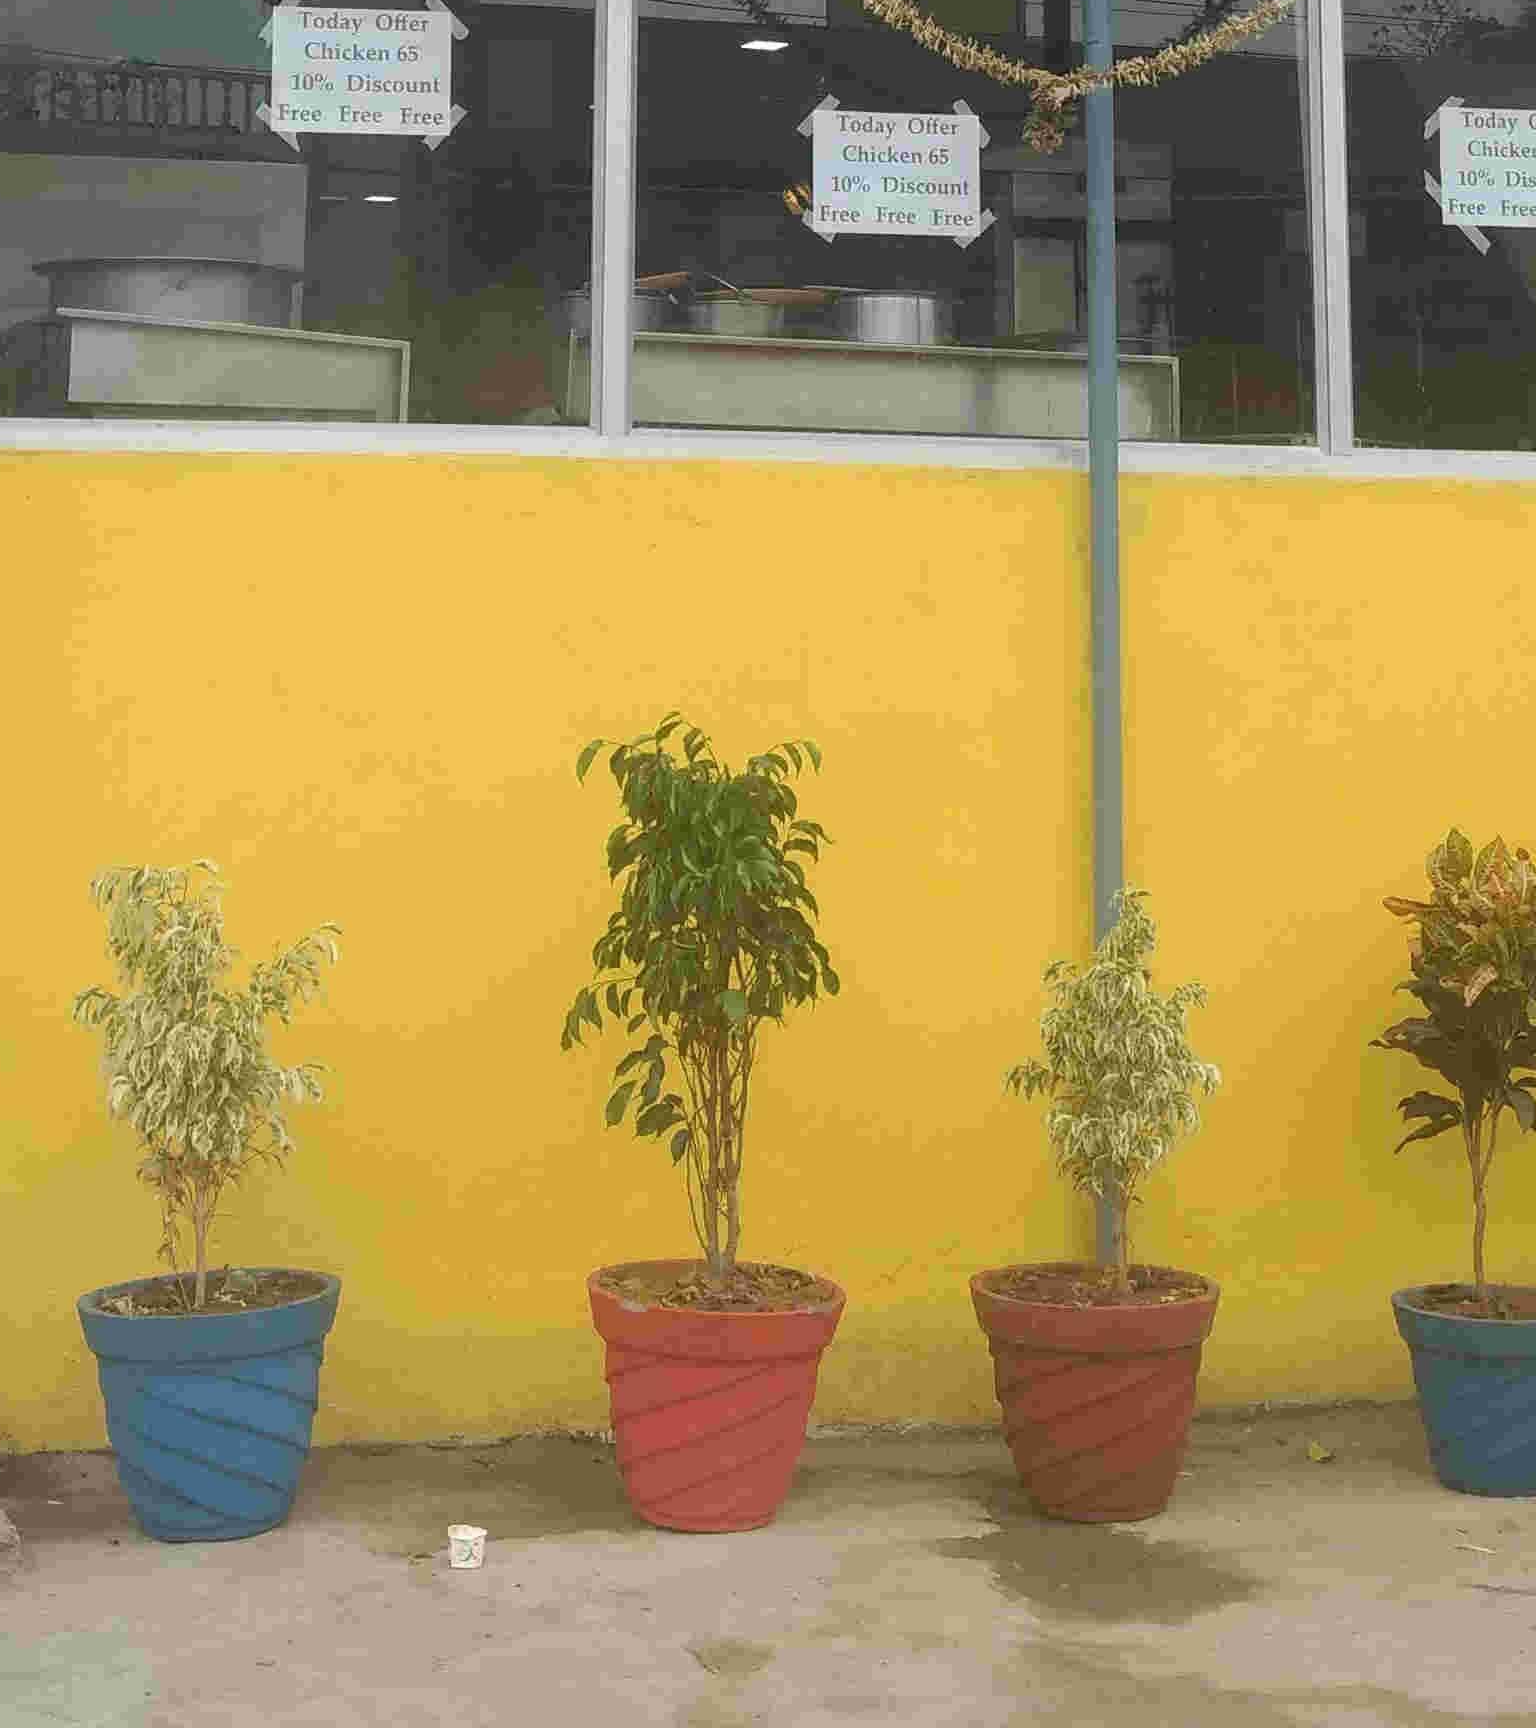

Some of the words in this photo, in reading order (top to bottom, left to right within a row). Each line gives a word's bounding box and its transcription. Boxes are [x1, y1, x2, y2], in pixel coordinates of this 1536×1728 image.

[299, 11, 363, 33] Today
[375, 14, 431, 33] Offer
[304, 41, 390, 62] Chicken
[397, 46, 420, 63] 65
[290, 72, 335, 92] 10%
[346, 75, 441, 94] Discount
[278, 103, 322, 123] Free
[338, 105, 384, 124] Free
[399, 107, 444, 126] Free
[1462, 111, 1519, 136] Today
[836, 114, 896, 139] Today
[907, 117, 960, 136] Offer
[842, 145, 923, 165] Chicken
[928, 148, 951, 166] 65
[830, 175, 871, 194] 10%
[881, 176, 968, 196] Discount
[1455, 170, 1496, 188] 10%
[819, 205, 861, 225] Free
[875, 206, 917, 226] Free
[931, 208, 974, 228] Free
[1447, 198, 1487, 217] Free
